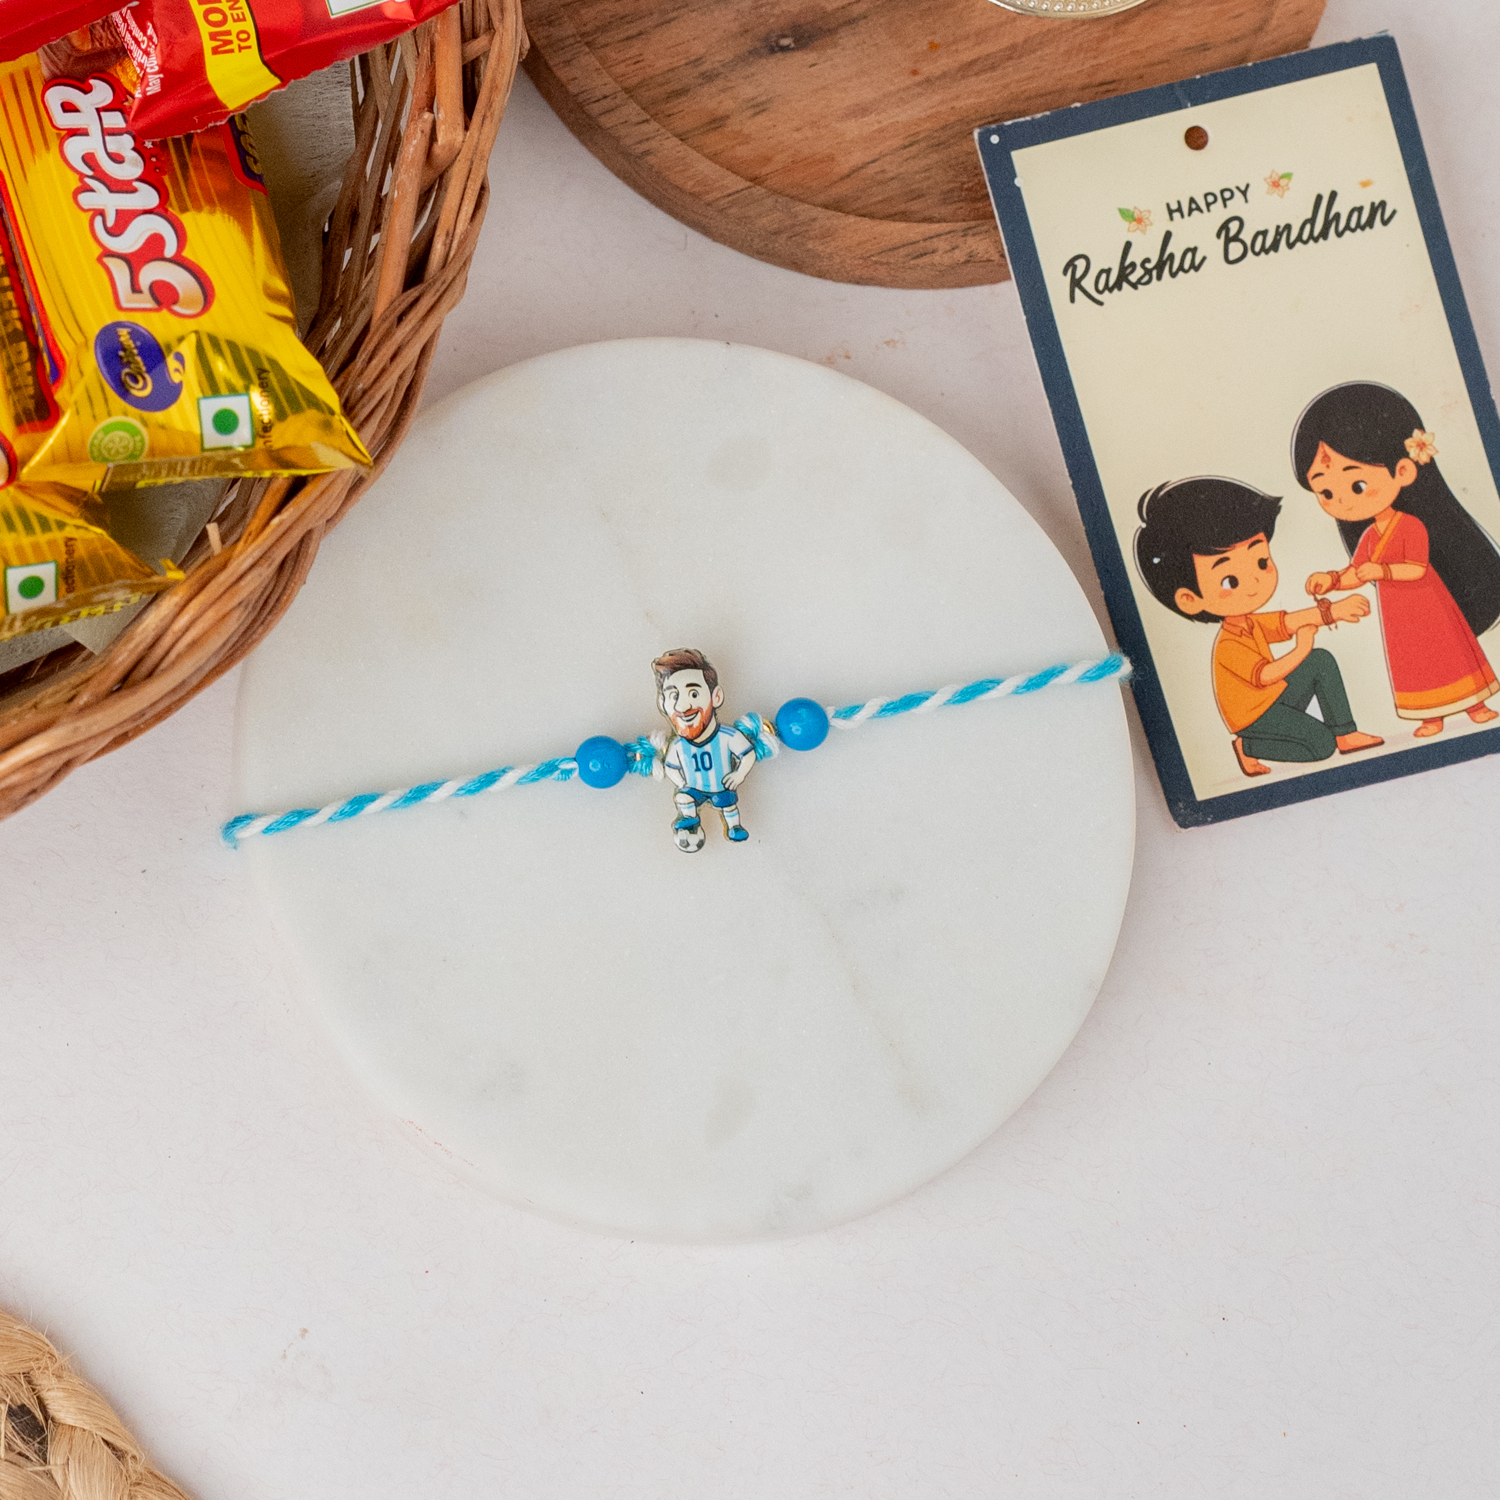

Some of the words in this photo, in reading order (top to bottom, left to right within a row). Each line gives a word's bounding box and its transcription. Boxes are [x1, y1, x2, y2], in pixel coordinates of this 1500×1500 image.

[233, 27, 254, 53] TO
[1166, 182, 1251, 221] HAPPY
[1062, 229, 1207, 306] Raksha
[1216, 190, 1398, 267] Bandhan
[249, 367, 280, 447] nfectionery
[692, 752, 712, 772] 10
